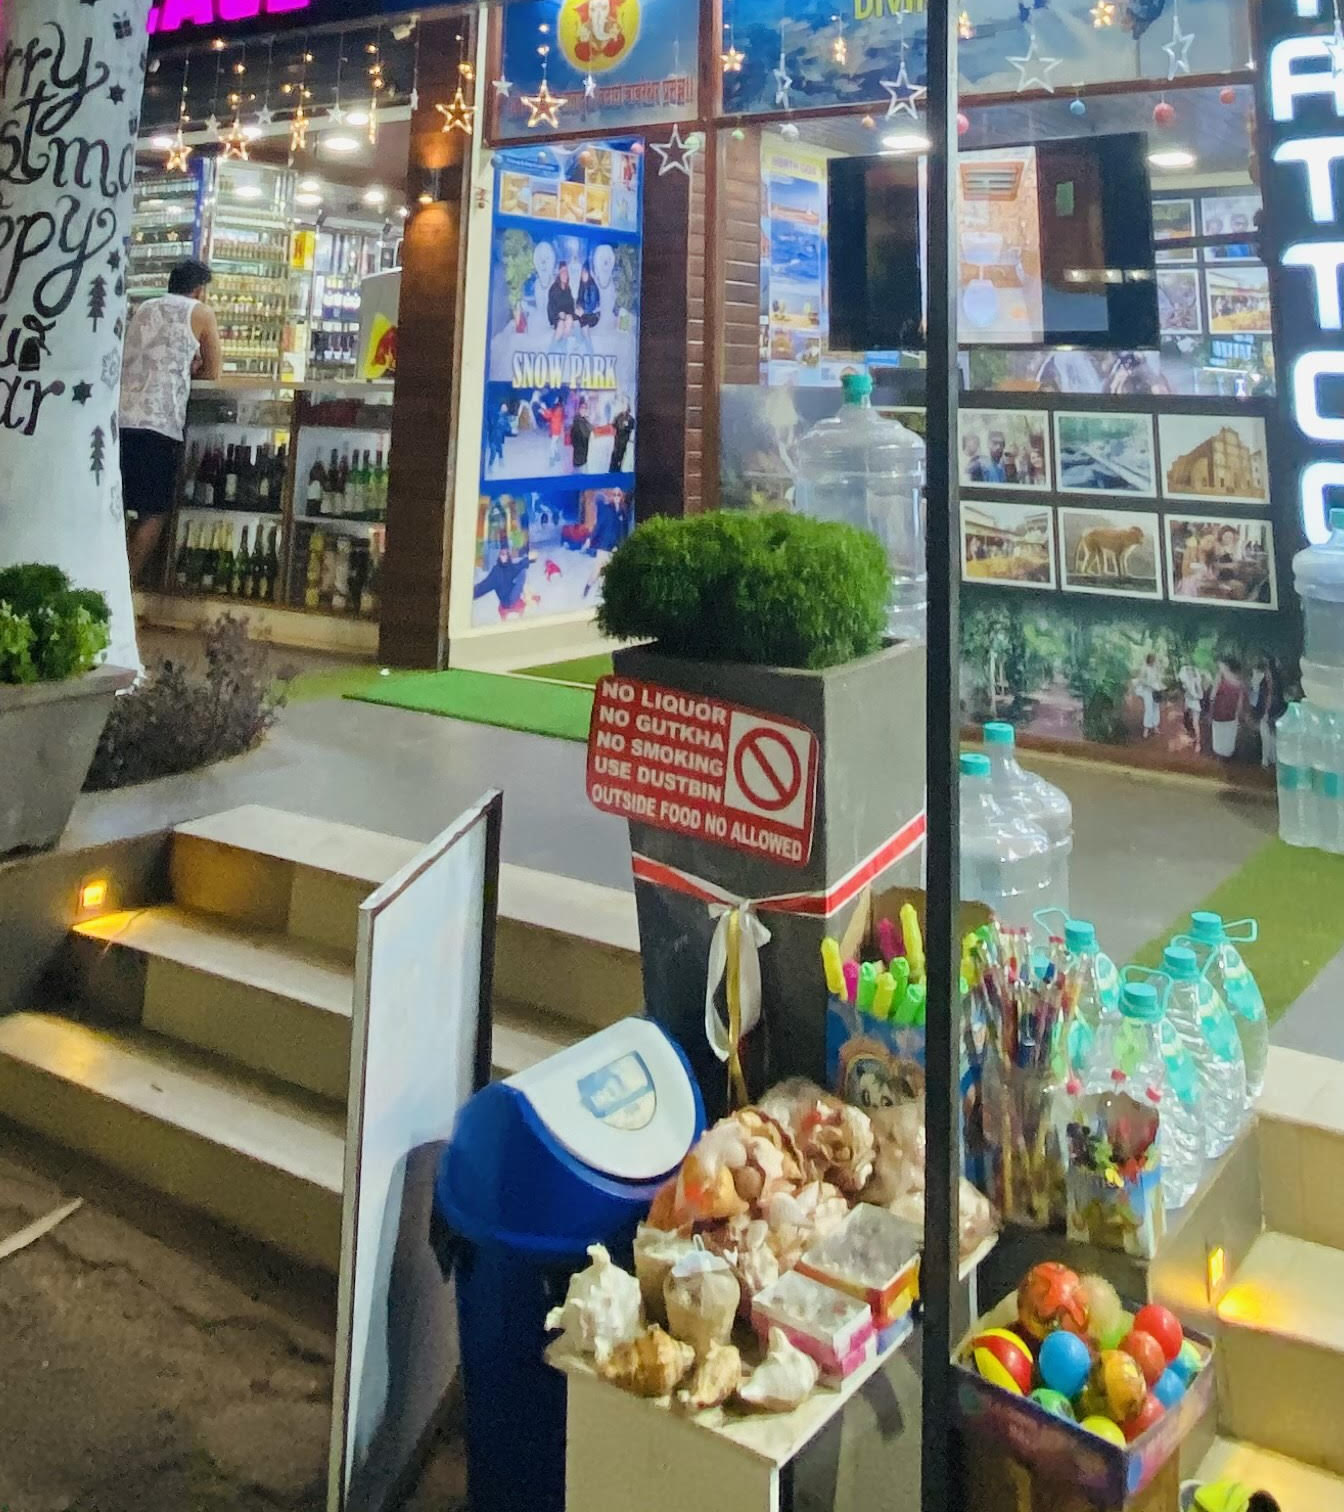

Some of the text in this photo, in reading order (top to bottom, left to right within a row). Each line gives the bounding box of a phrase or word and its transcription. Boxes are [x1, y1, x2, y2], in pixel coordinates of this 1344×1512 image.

[511, 350, 618, 391] SNOW PARK
[602, 679, 728, 726] NO LIQUOR
[599, 705, 725, 753] NO GUTKHA
[596, 730, 724, 778] NO SMOKING
[594, 755, 723, 804] USE DUSTBIN
[592, 784, 802, 862] OUTSIDE FOOD NO ALLOWED
